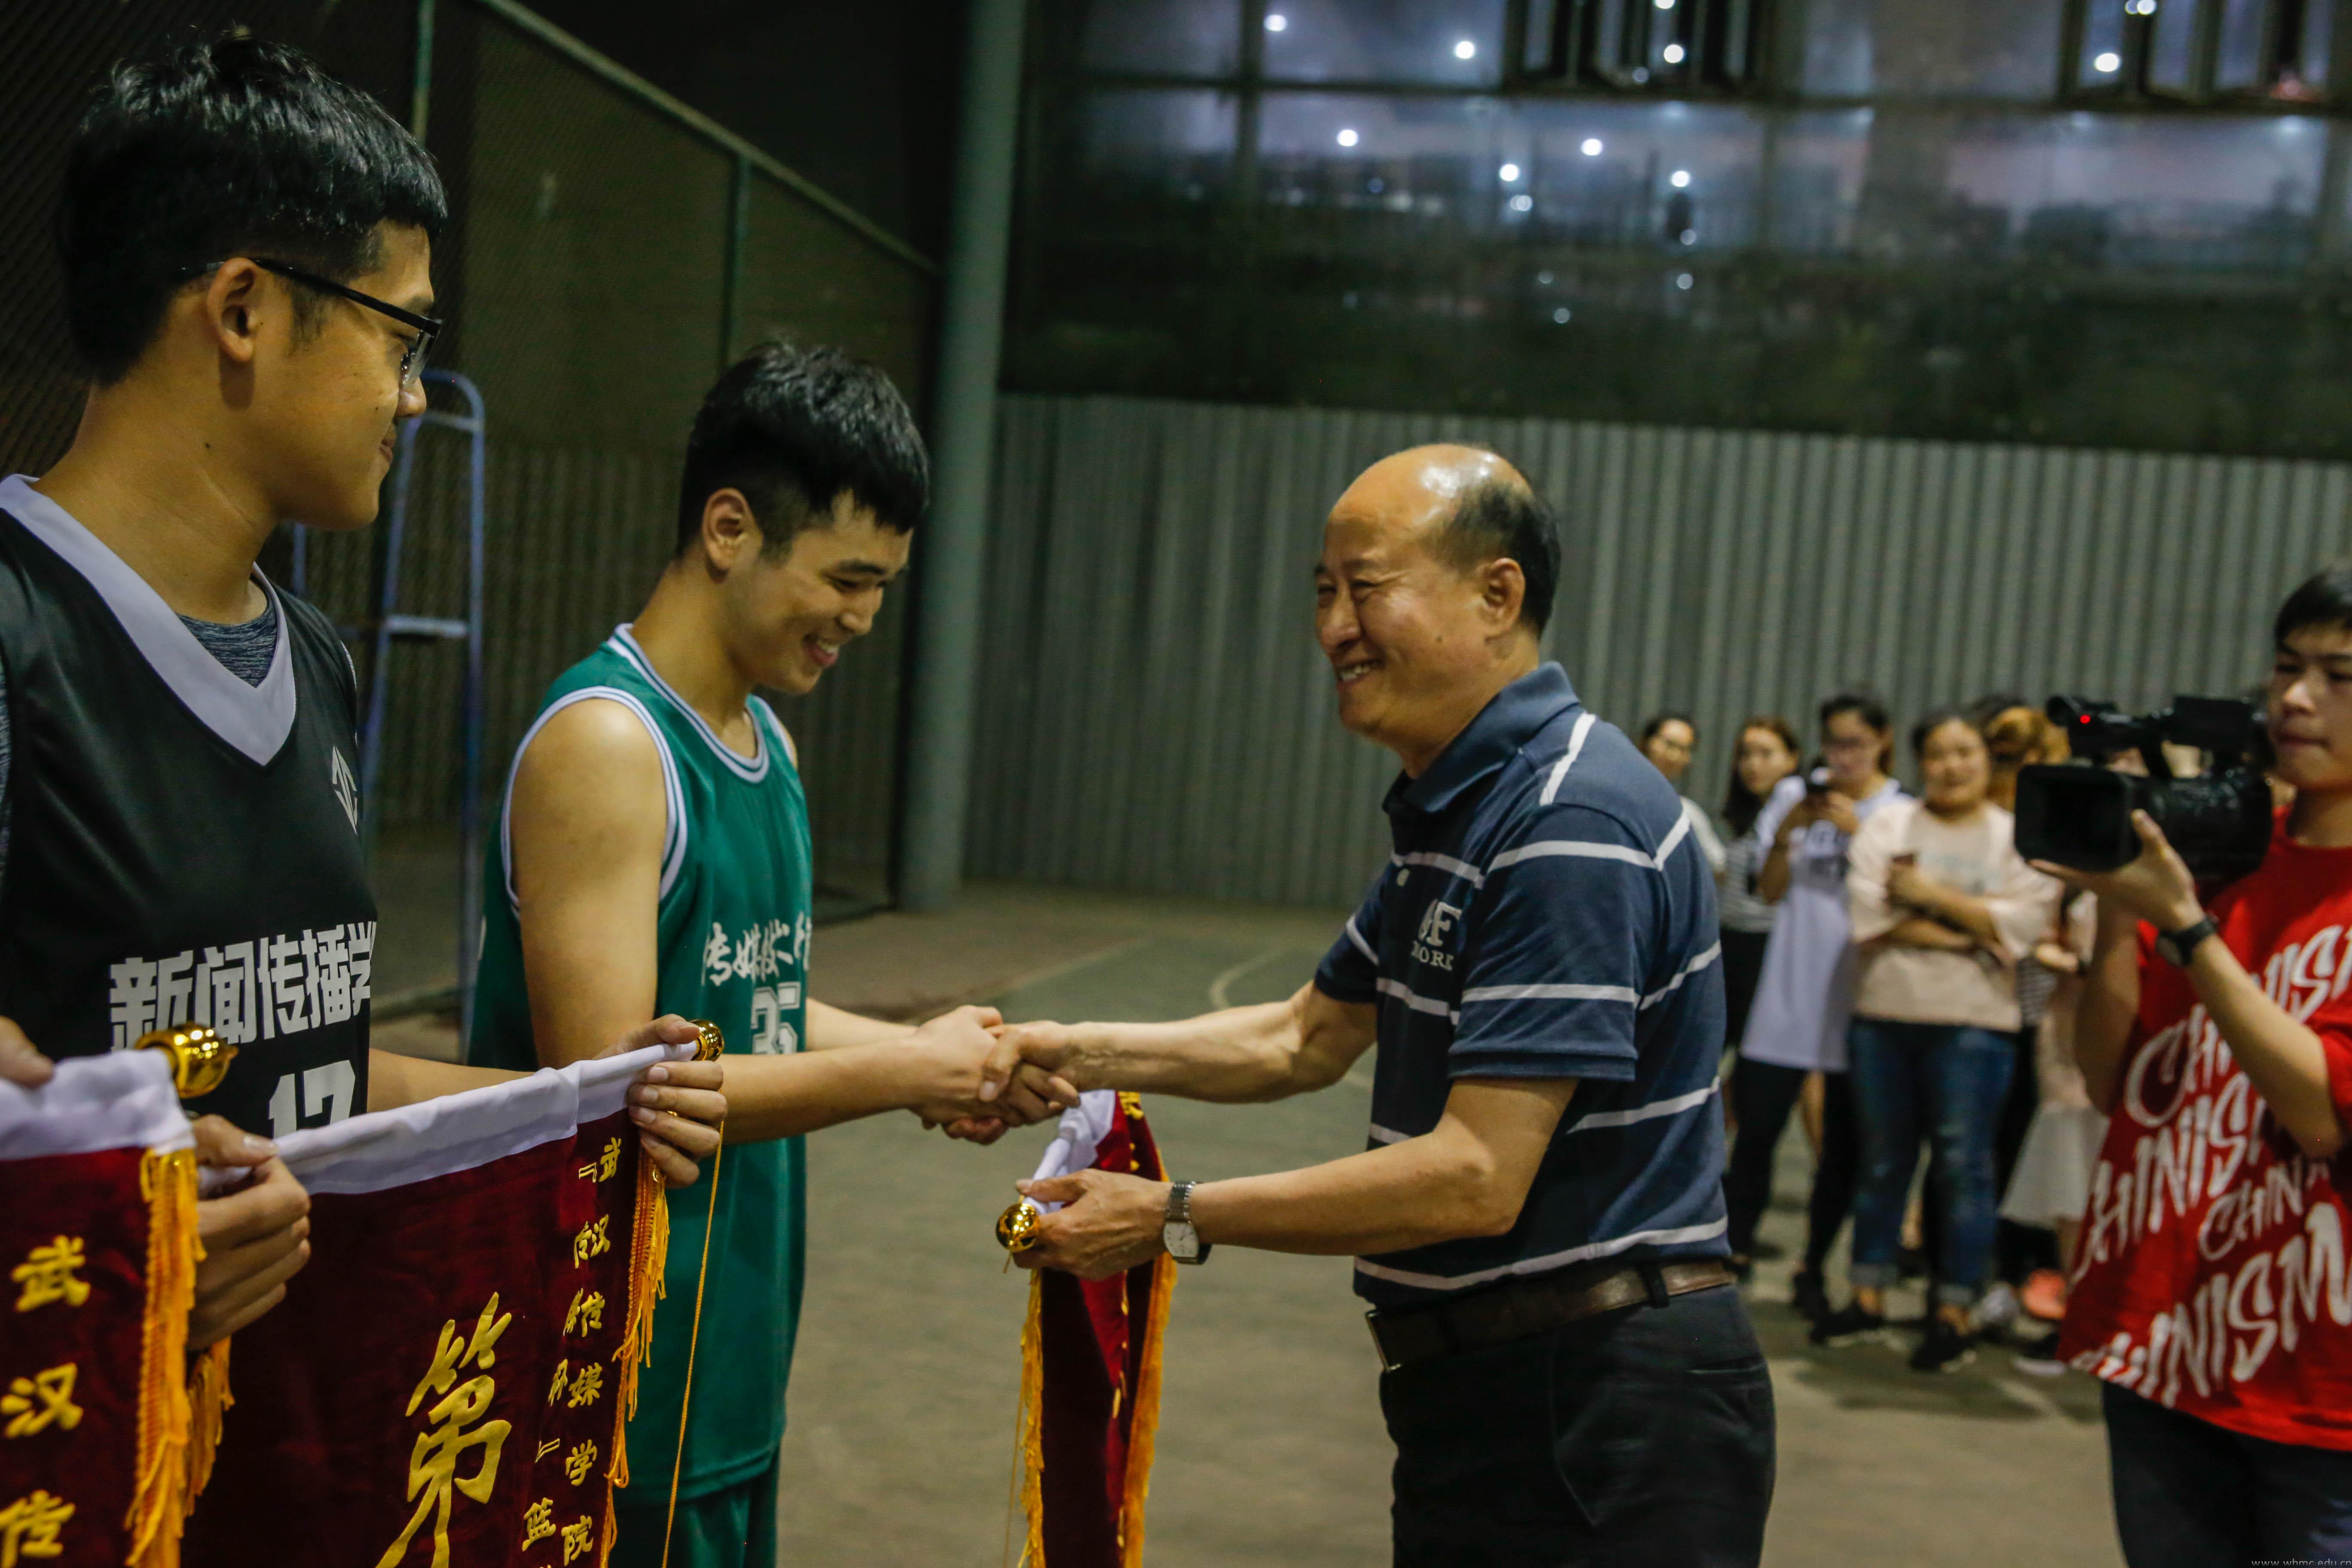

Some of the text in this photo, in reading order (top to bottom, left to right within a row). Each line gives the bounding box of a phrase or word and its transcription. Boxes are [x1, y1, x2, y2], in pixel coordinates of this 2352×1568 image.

[110, 922, 377, 1052] 新闻传播学
[270, 1060, 355, 1139] 17
[0, 1235, 91, 1568] 武汉传
[375, 1291, 512, 1568] 第
